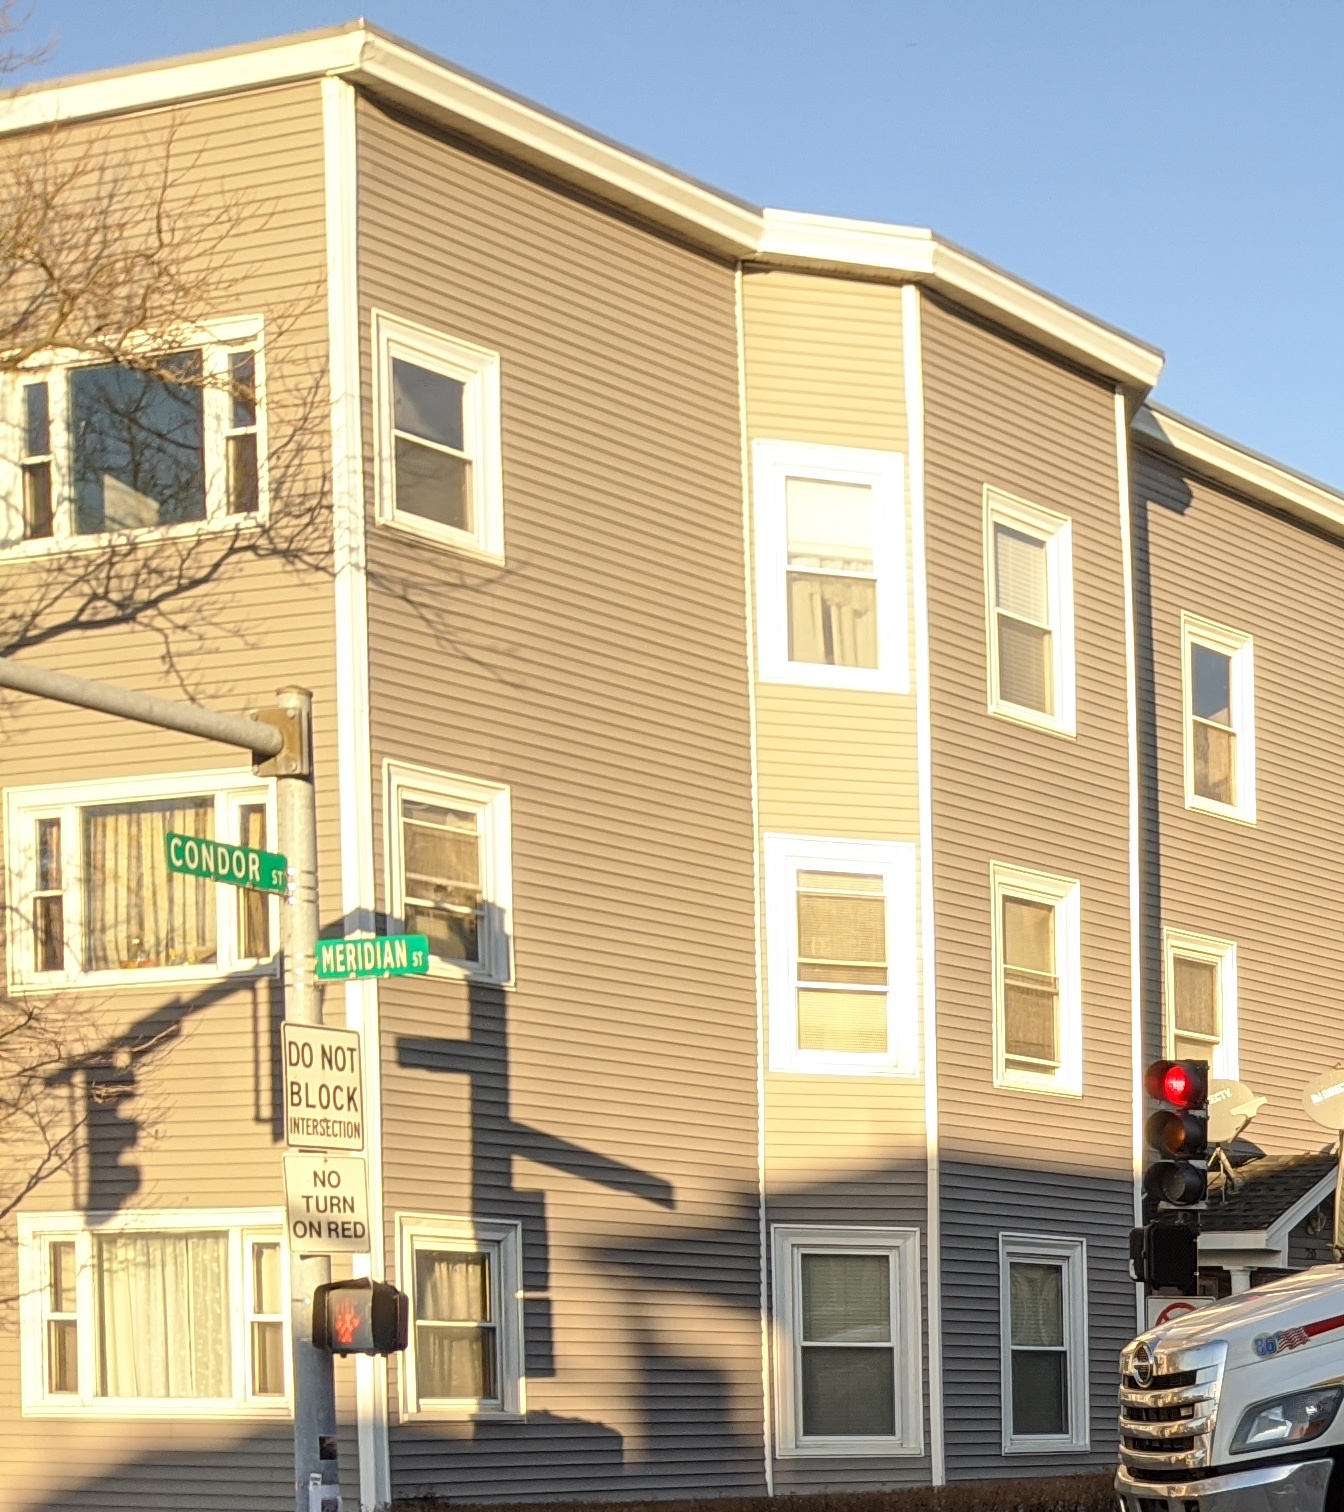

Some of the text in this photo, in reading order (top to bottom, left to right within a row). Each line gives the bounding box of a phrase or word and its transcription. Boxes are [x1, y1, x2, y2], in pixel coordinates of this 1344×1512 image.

[171, 836, 284, 886] CONDOR ST
[322, 940, 424, 973] MERIDIAN ST
[288, 1041, 358, 1073] DO NOT
[290, 1083, 359, 1113] BLOCK
[289, 1116, 361, 1141] INTERSECTION
[313, 1170, 341, 1190] NO
[302, 1195, 356, 1215] TURN
[293, 1219, 366, 1240] ON RED
